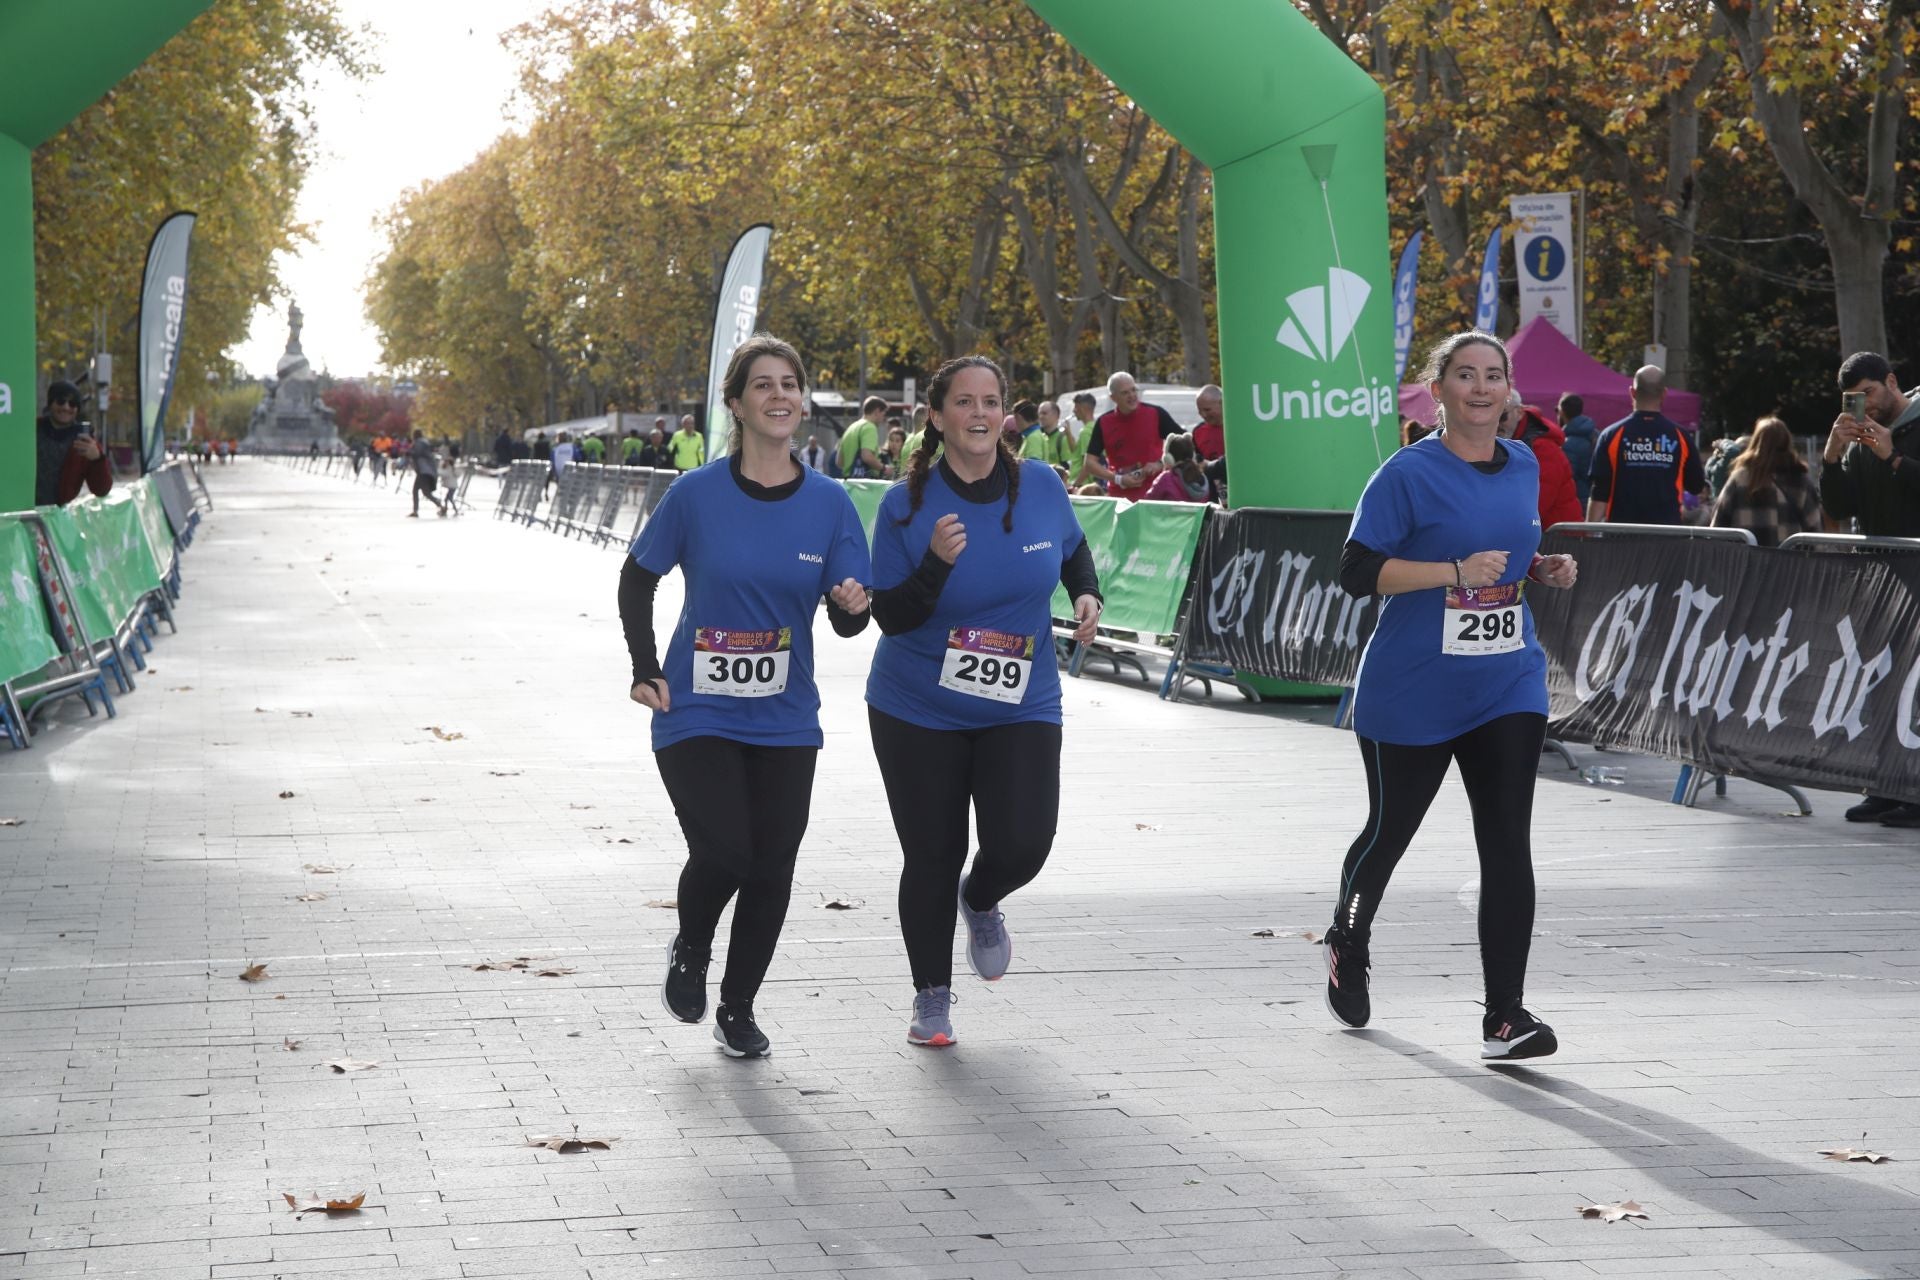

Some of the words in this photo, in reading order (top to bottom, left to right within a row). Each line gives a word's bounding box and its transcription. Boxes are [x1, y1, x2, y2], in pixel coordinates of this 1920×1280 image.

[1518, 203, 1544, 212] Oficina
[1545, 203, 1555, 211] de
[1252, 376, 1393, 428] Unicaja
[1632, 440, 1652, 451] red
[1655, 434, 1678, 453] itv
[1023, 541, 1052, 553] SANDRA
[798, 552, 823, 564] MARÍA
[1208, 548, 1265, 638] El
[1478, 592, 1506, 602] EMPRESAS
[1457, 610, 1515, 641] 298
[728, 631, 755, 639] CARRERA
[755, 631, 763, 639] DE
[981, 631, 1007, 641] CARRERA
[981, 638, 1013, 649] EMPRESAS
[1575, 582, 1659, 702] El
[1650, 579, 1809, 733] Norte
[1809, 614, 1892, 742] de
[708, 656, 775, 684] 300
[954, 654, 1021, 689] 299
